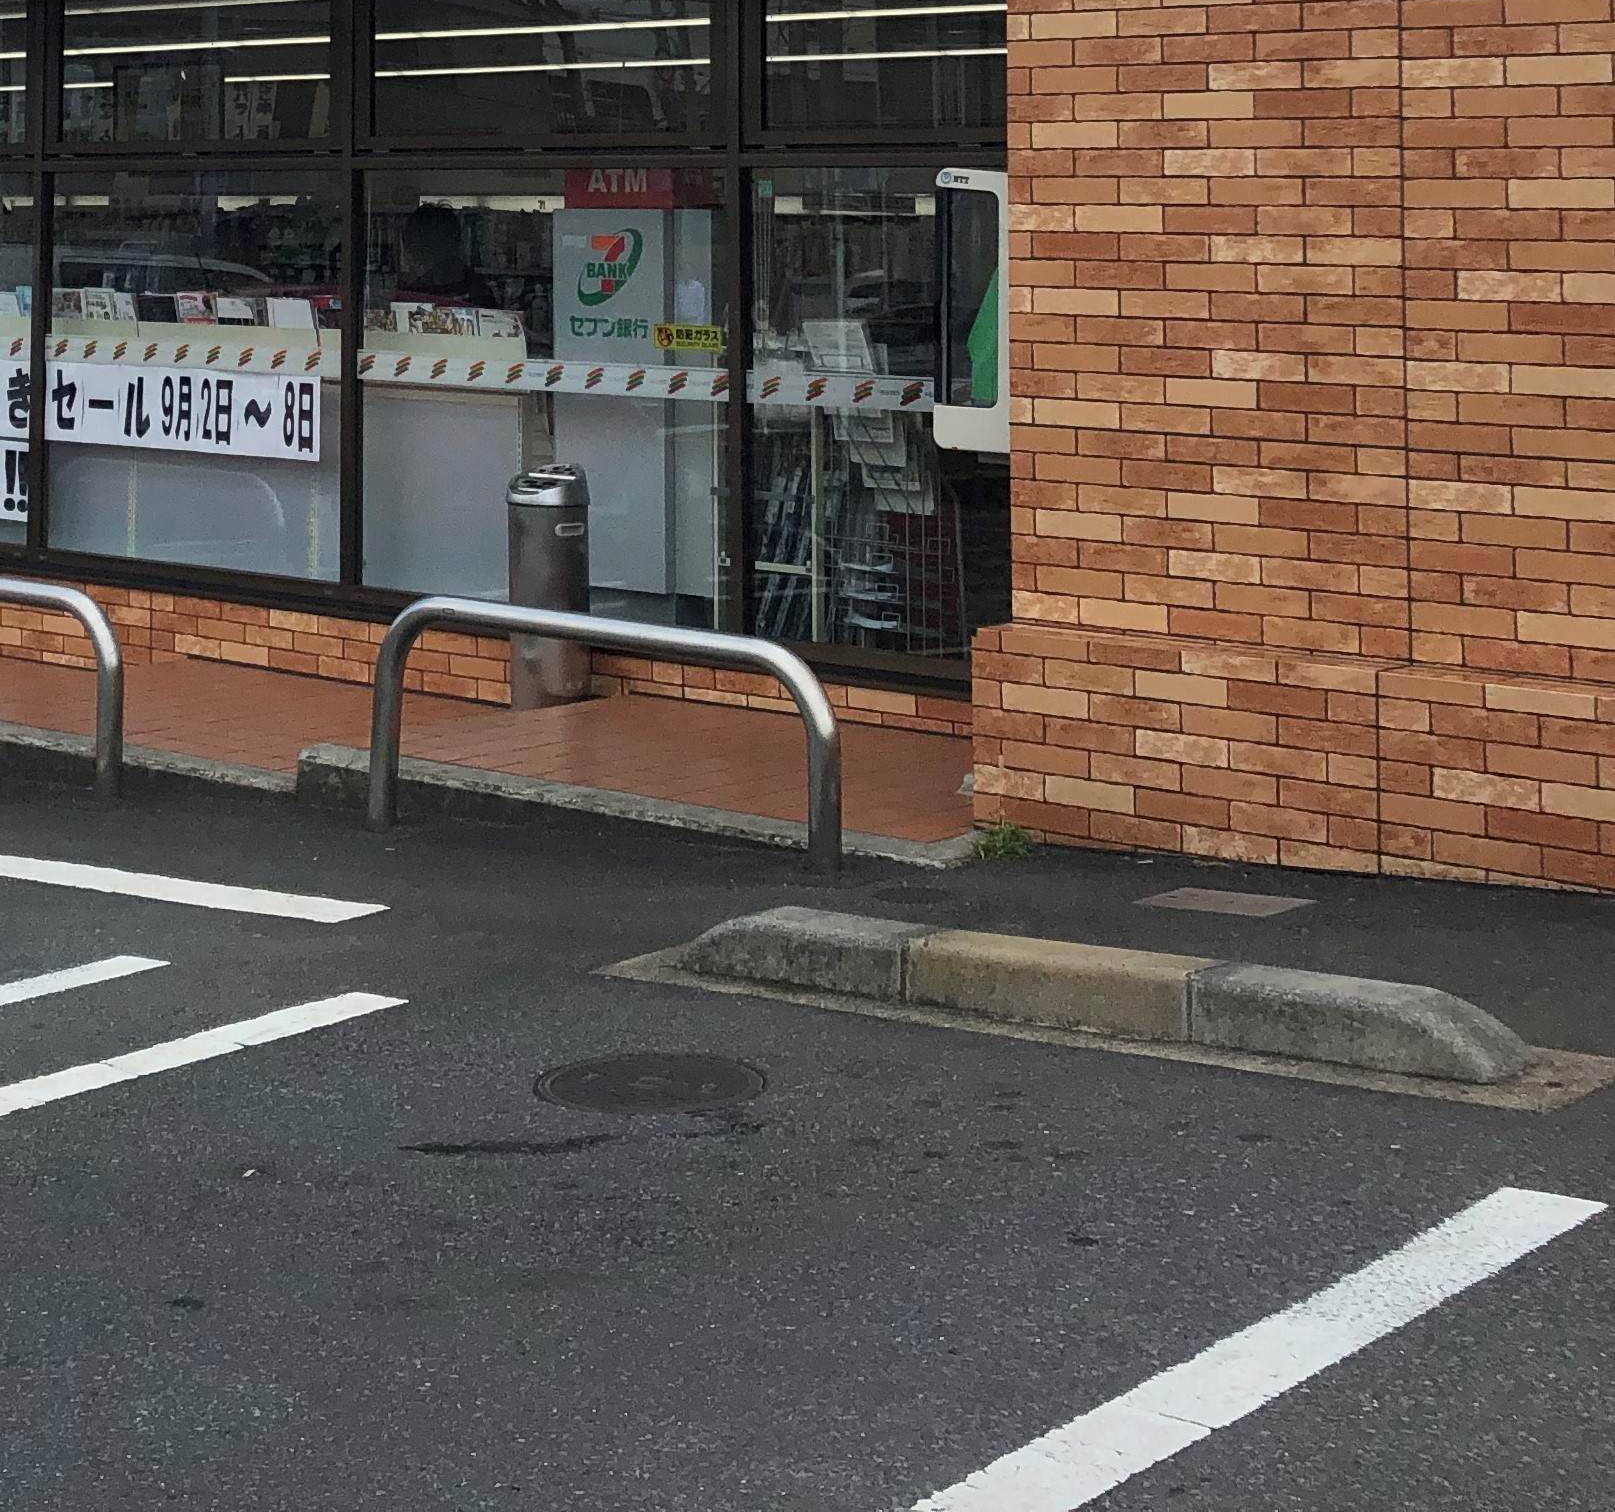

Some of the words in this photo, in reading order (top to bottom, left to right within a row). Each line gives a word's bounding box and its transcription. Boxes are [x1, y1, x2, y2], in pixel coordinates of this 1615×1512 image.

[587, 168, 647, 193] ATM
[586, 262, 631, 279] BANK
[569, 315, 649, 339] セブン銀行
